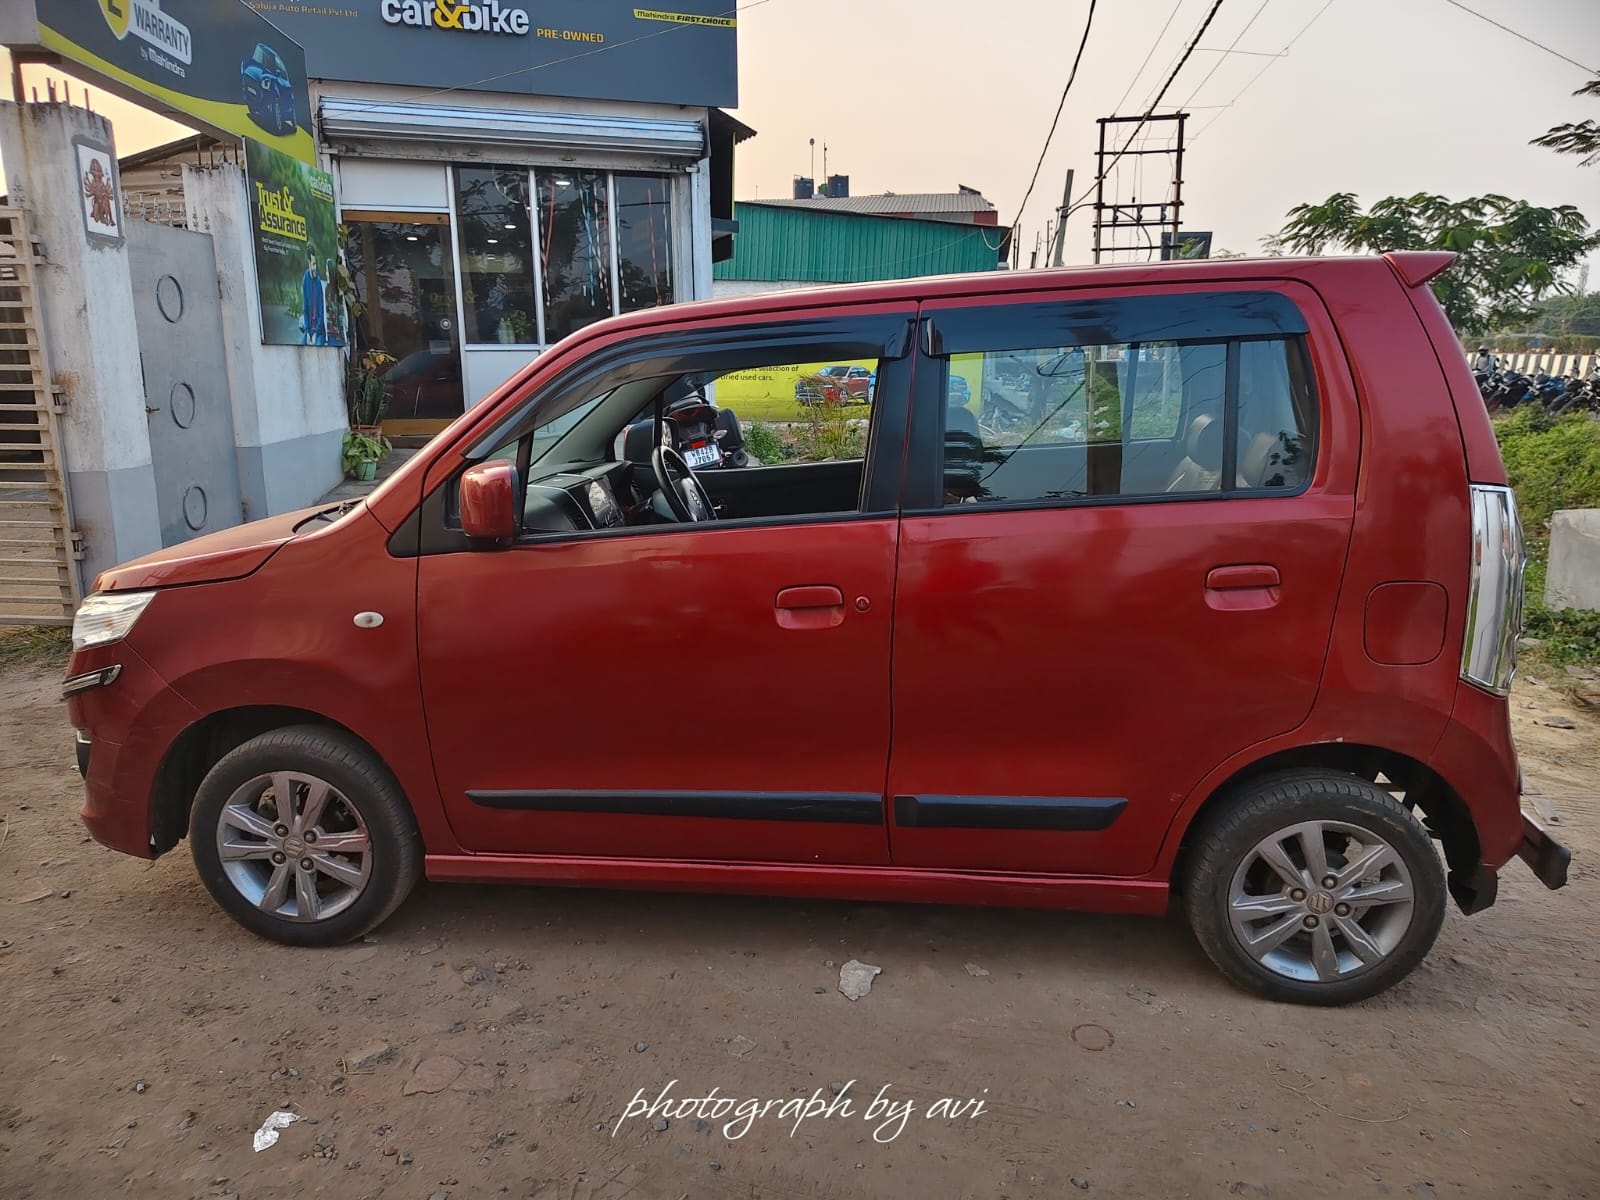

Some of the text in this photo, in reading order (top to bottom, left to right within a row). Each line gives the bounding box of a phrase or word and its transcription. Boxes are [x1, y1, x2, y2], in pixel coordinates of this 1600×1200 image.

[279, 4, 299, 12] Auto
[301, 6, 327, 15] Retail
[382, 0, 529, 34] car&bike
[701, 17, 731, 25] CHOICE
[134, 2, 190, 56] WARRANTY
[536, 28, 604, 43] PRE-OWNED
[256, 181, 281, 211] Trust
[283, 186, 294, 214] &
[259, 204, 306, 237] Assurance
[740, 373, 757, 381] used
